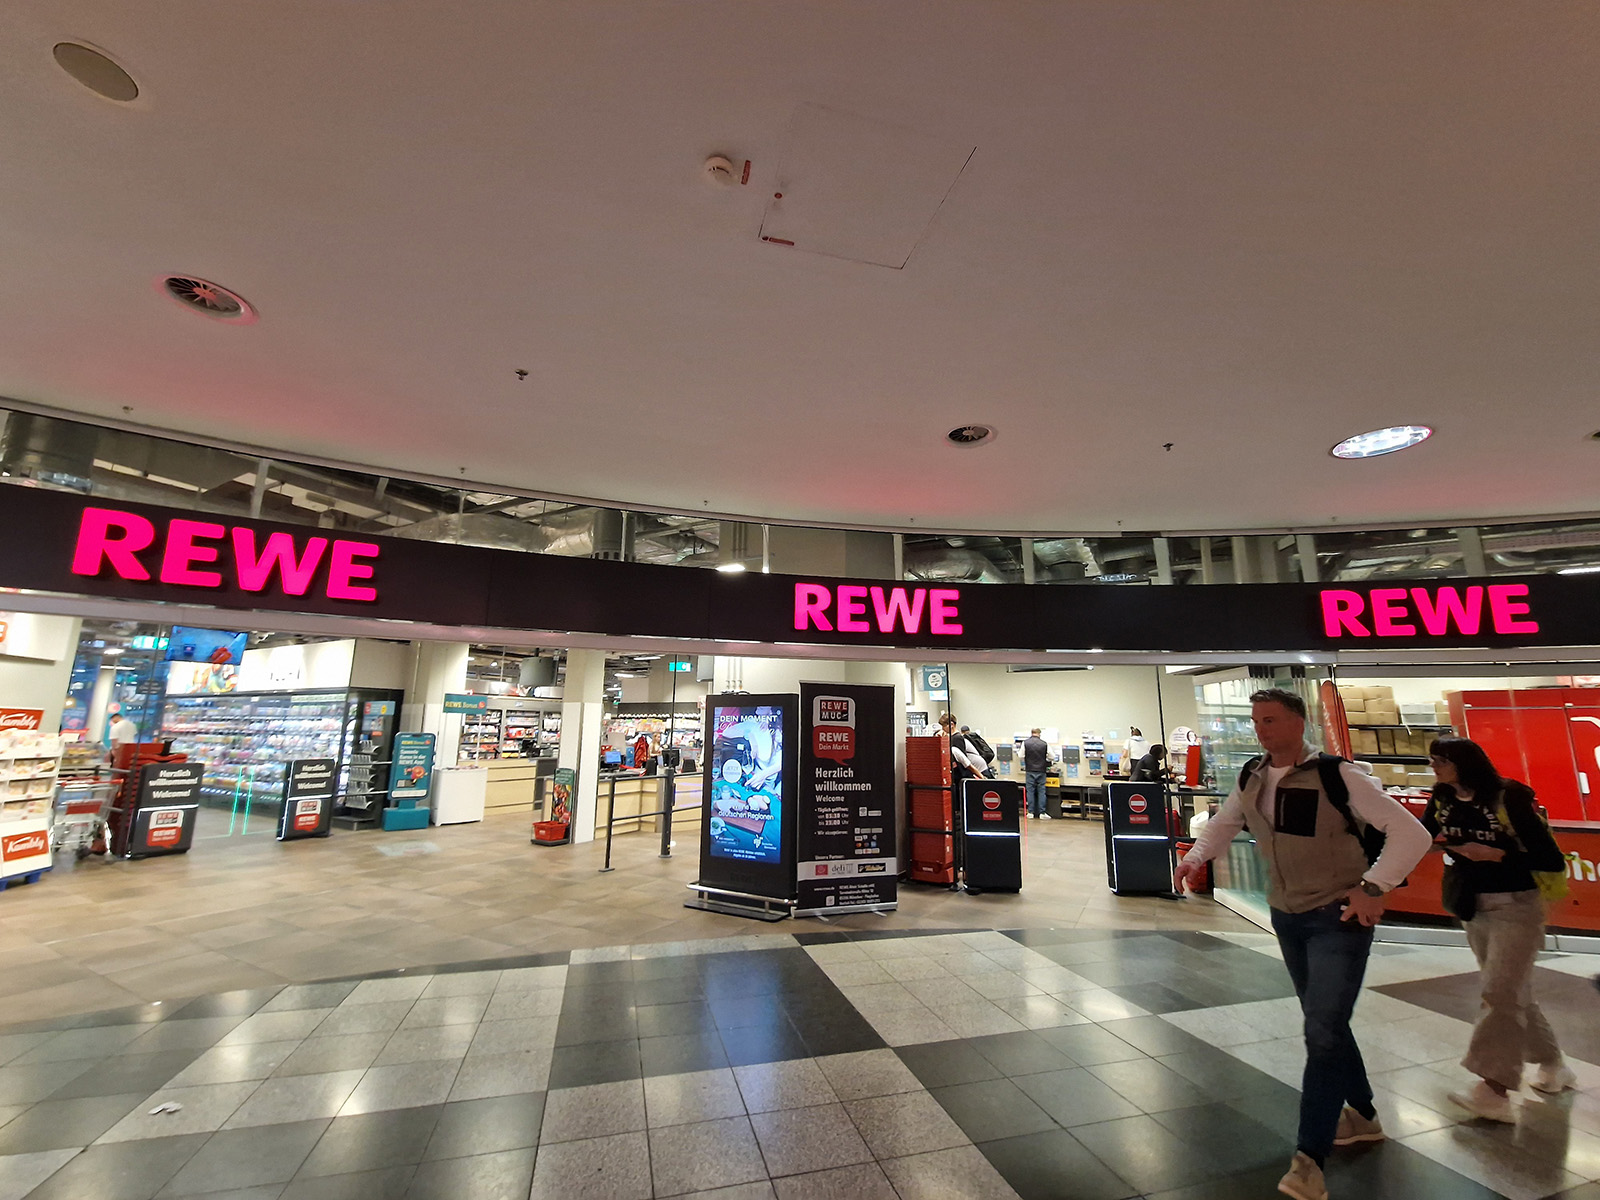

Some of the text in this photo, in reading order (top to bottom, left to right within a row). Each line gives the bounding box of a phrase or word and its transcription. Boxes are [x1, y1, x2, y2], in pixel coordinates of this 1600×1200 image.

[72, 507, 379, 601] REWE
[794, 583, 963, 635] REWE
[1320, 584, 1538, 637] REWE
[821, 701, 847, 710] REWE
[0, 713, 37, 729] Kambly
[819, 732, 849, 742] REWE
[815, 767, 854, 778] Herzlich
[815, 780, 872, 792] willkommen
[815, 795, 845, 803] Welcome
[7, 837, 44, 853] Kambly
